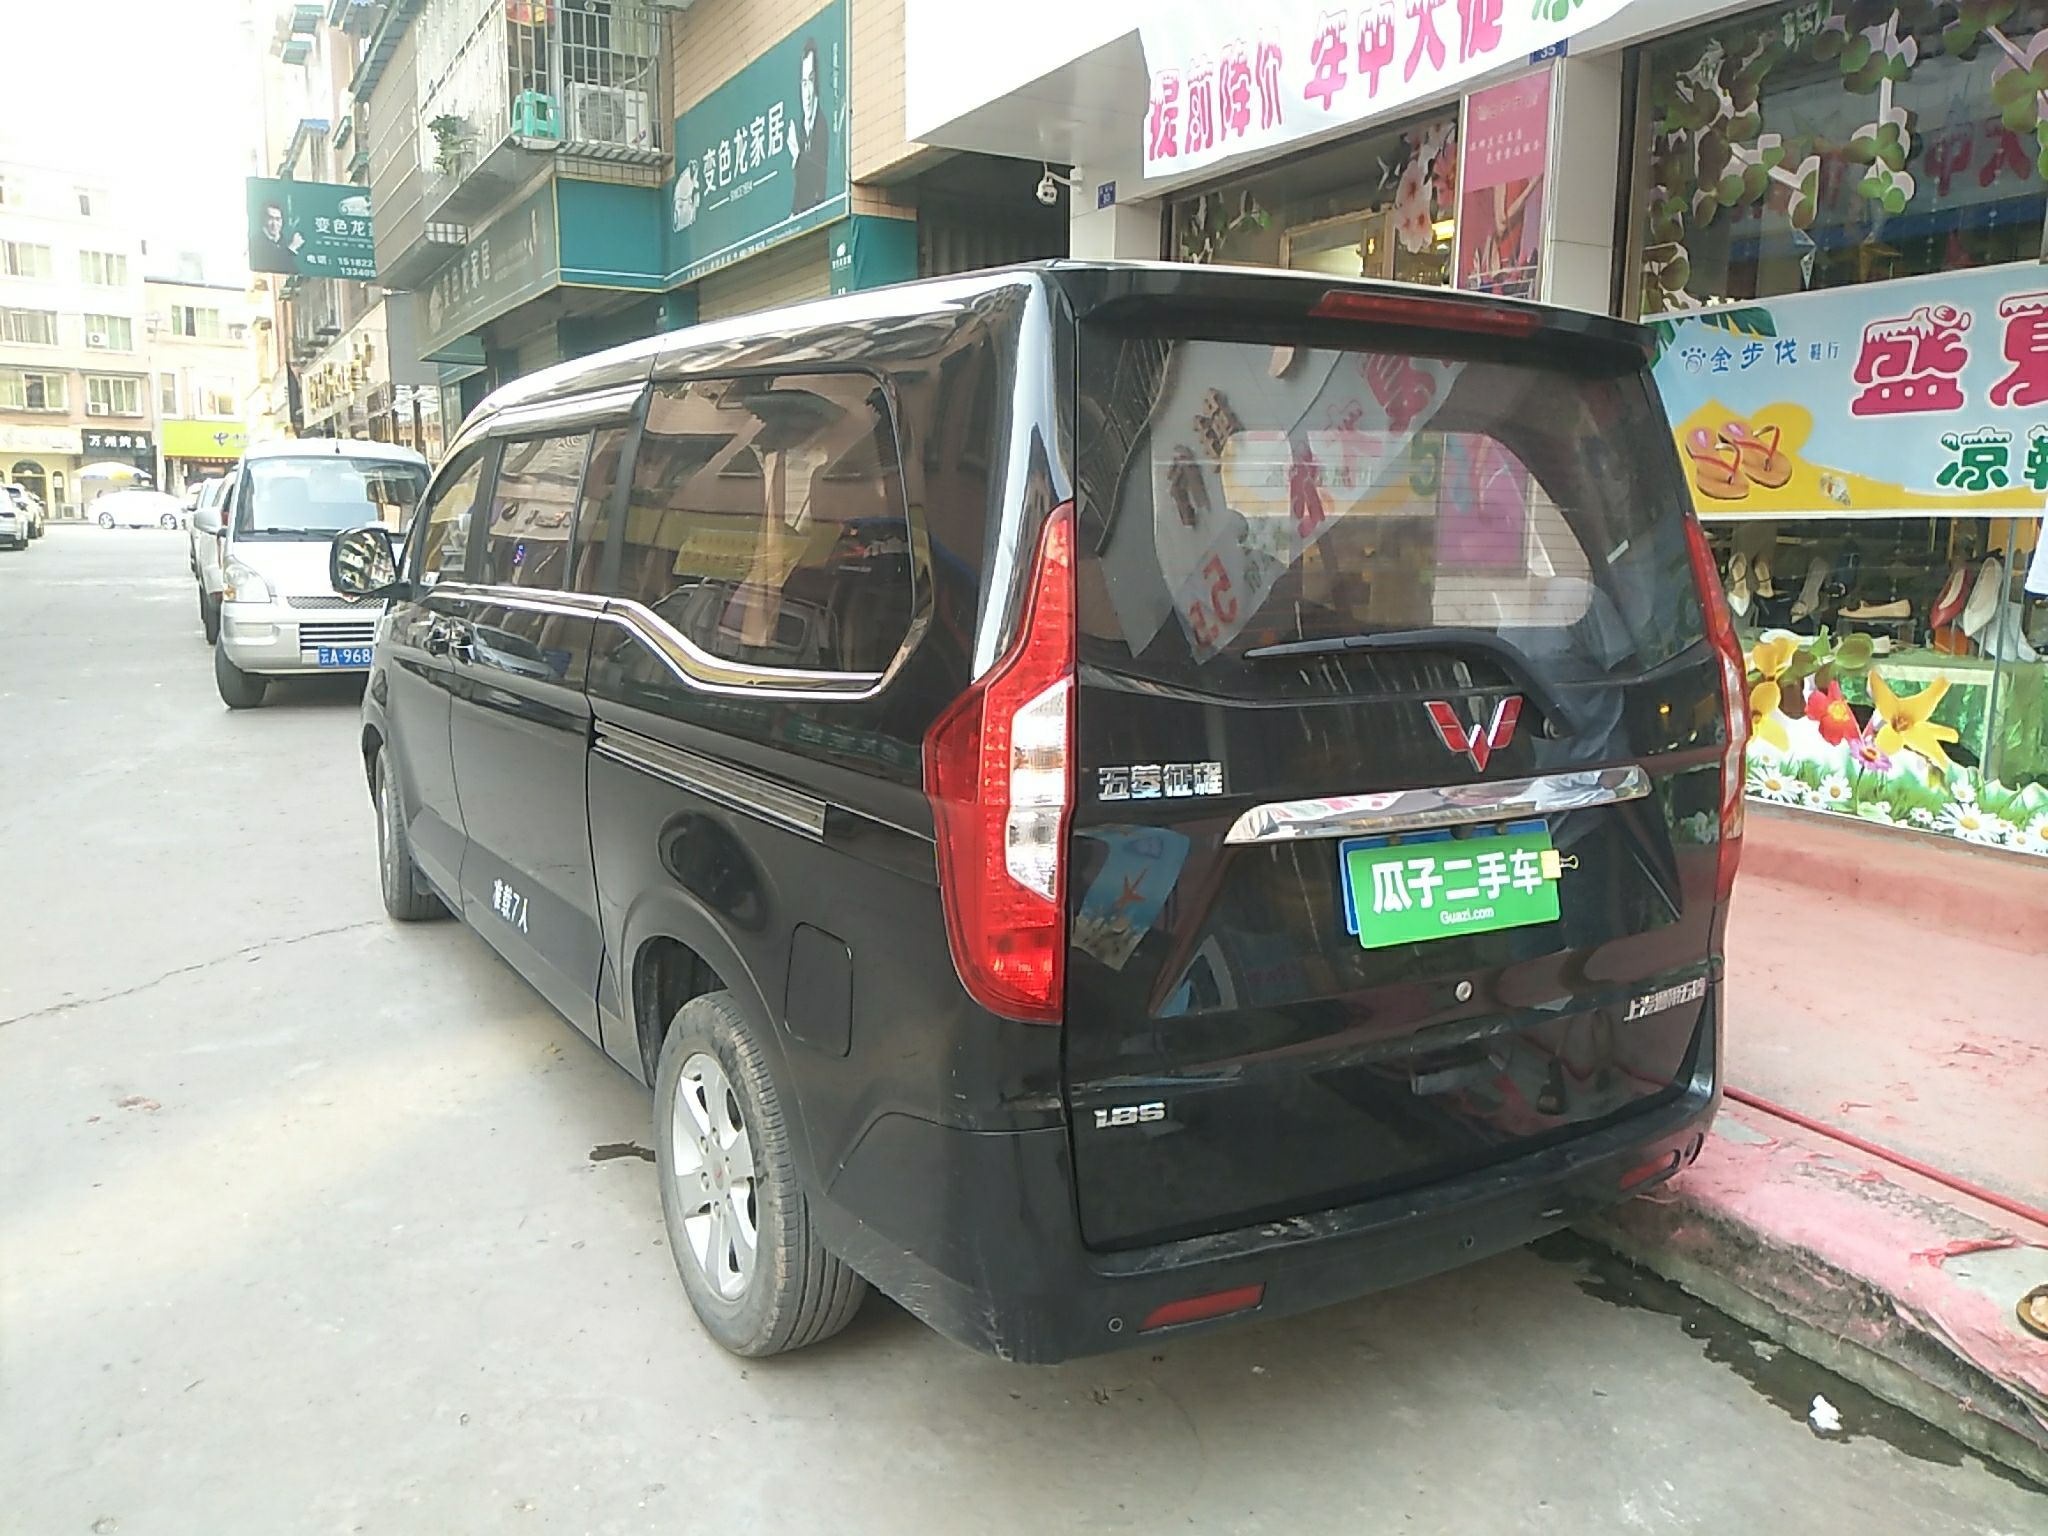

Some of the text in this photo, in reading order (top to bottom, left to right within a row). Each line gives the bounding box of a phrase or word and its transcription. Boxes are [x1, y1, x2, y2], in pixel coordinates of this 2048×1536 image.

[1148, 27, 1283, 162] 提前降价
[702, 101, 785, 197] 变色龙家居
[315, 217, 373, 236] 变色龙
[1098, 762, 1223, 801] 五菱征程
[1371, 848, 1543, 914] 瓜子二手车
[1440, 906, 1495, 925] Guazi.com
[1093, 1101, 1166, 1129] 1.8S
